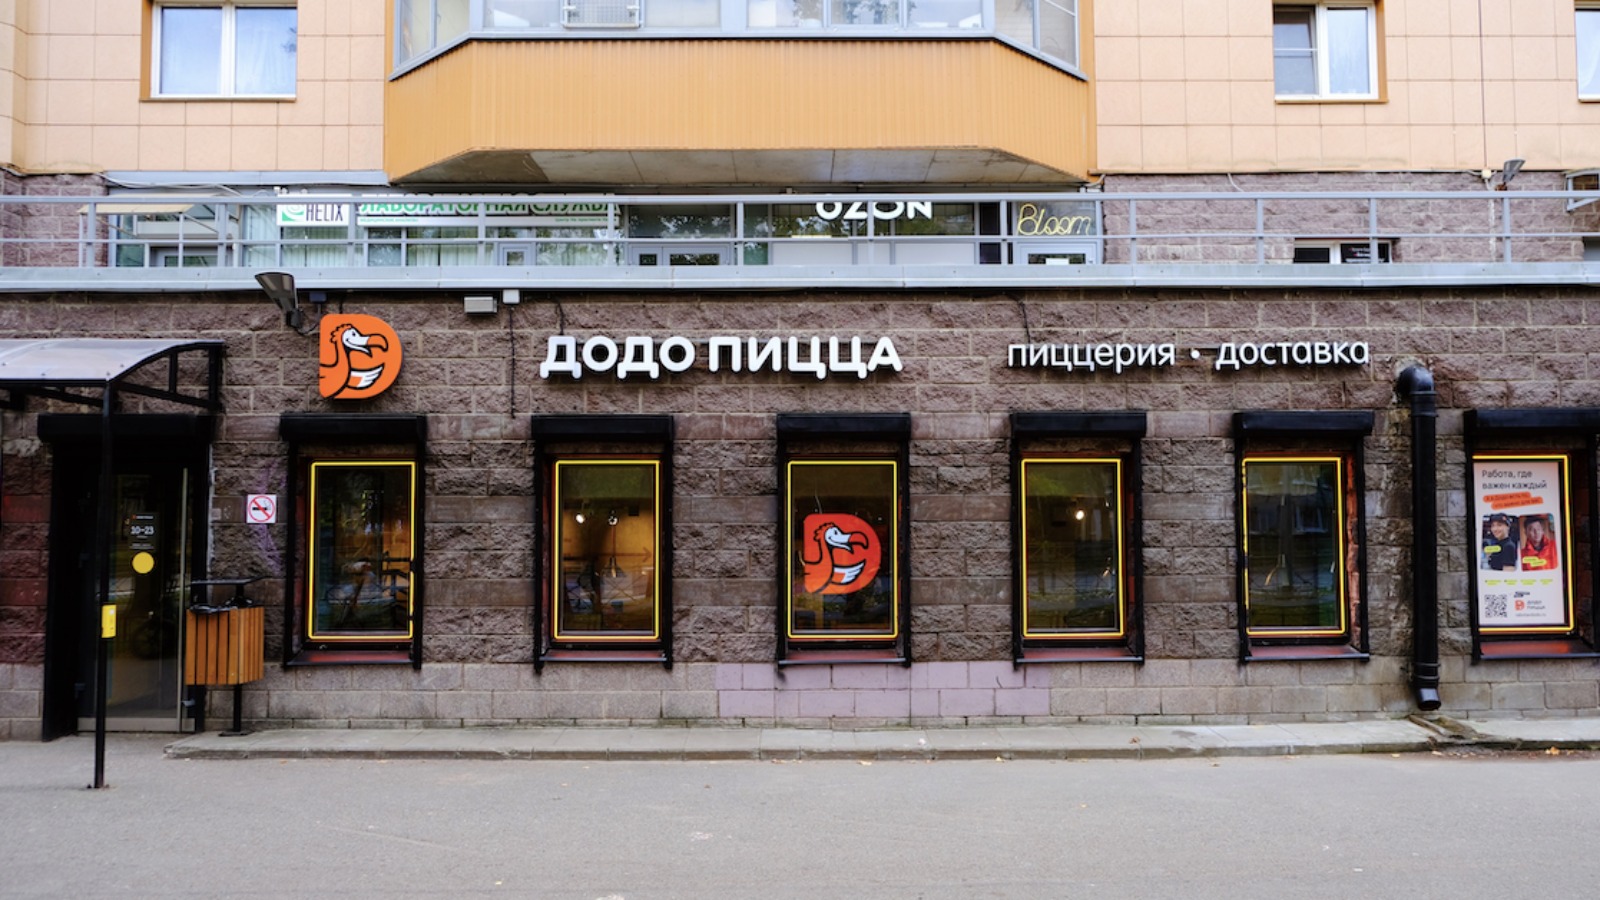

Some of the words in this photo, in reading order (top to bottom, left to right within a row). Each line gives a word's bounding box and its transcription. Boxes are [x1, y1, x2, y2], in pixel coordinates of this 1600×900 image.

[306, 203, 343, 221] HELIX
[816, 202, 932, 220] OZON
[1017, 203, 1091, 236] Bloom
[540, 336, 695, 378] ДОДО
[709, 336, 903, 379] ПИЦЦА
[1008, 343, 1176, 373] пиццерия
[1215, 341, 1370, 371] доставка
[1481, 469, 1516, 479] Работа,
[1517, 470, 1533, 479] где
[1482, 482, 1510, 490] важен
[1512, 479, 1548, 490] каждый
